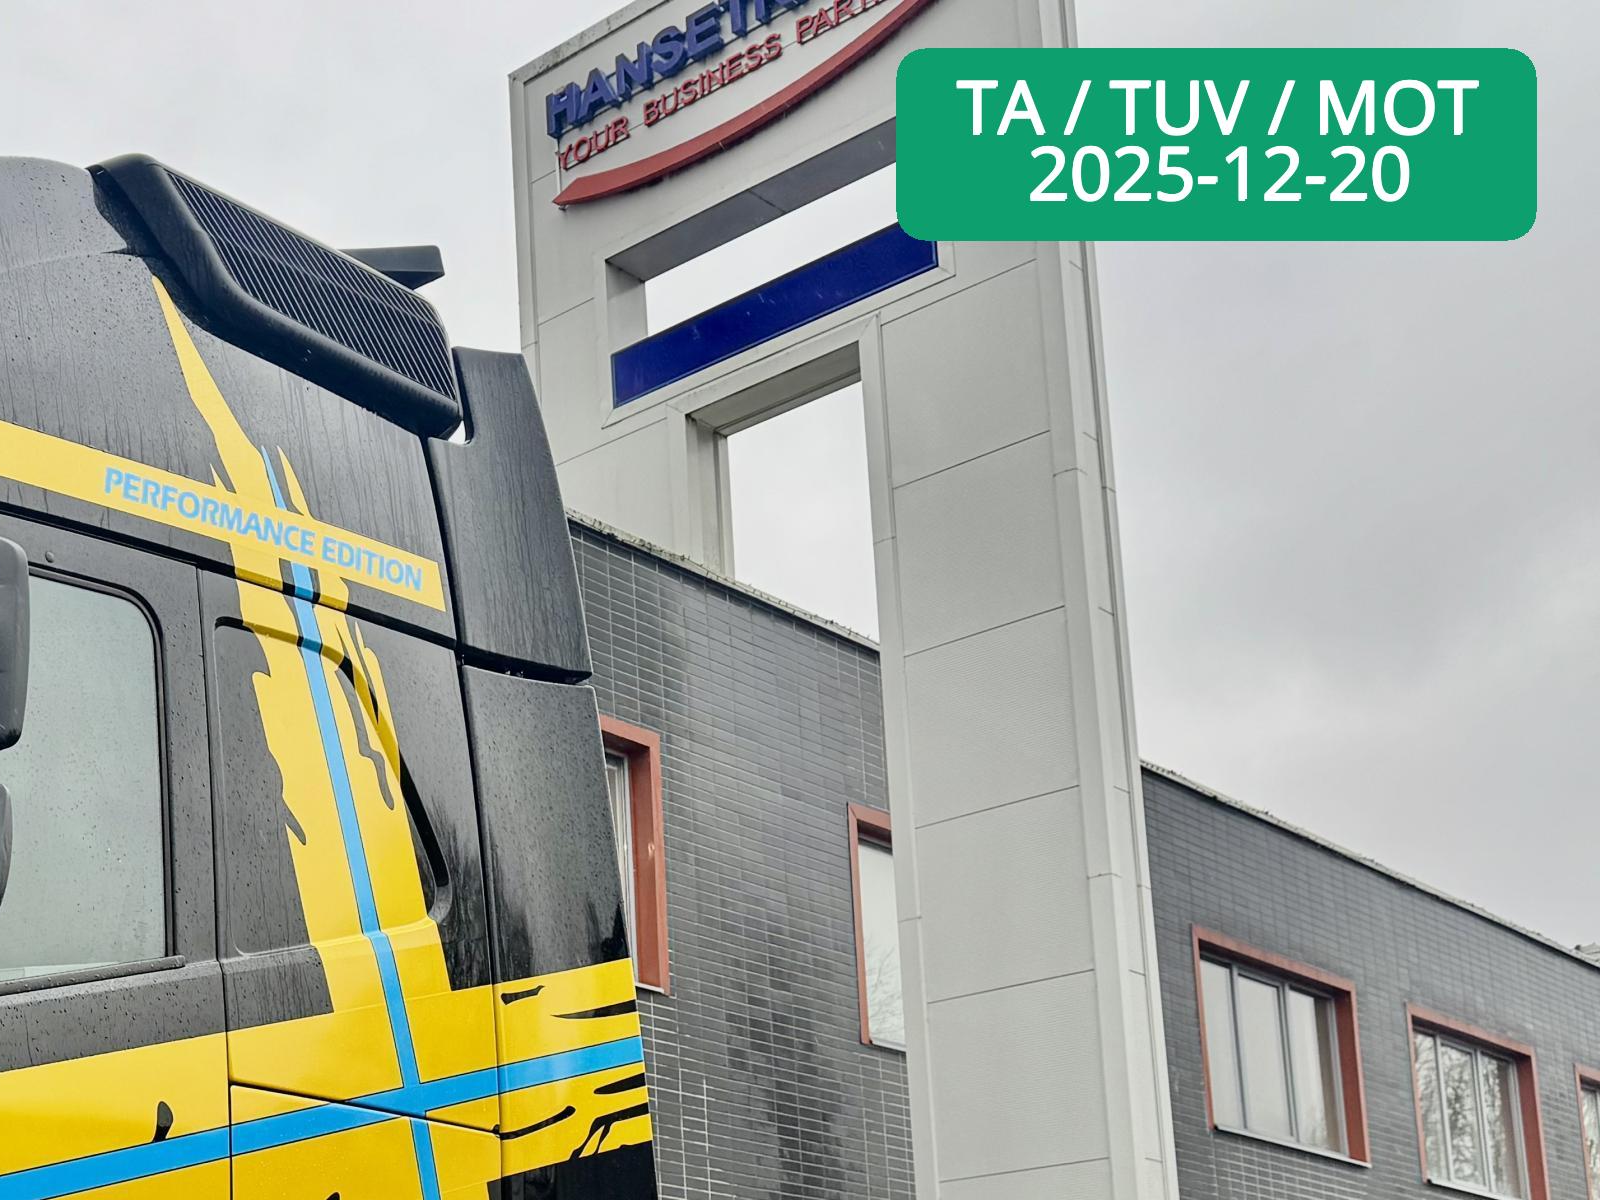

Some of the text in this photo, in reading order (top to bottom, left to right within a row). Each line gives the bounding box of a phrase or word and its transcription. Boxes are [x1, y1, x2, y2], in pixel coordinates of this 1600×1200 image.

[559, 0, 887, 170] YOUR BUSINESS PAR
[104, 466, 424, 592] PERFORMANCE EDITION
